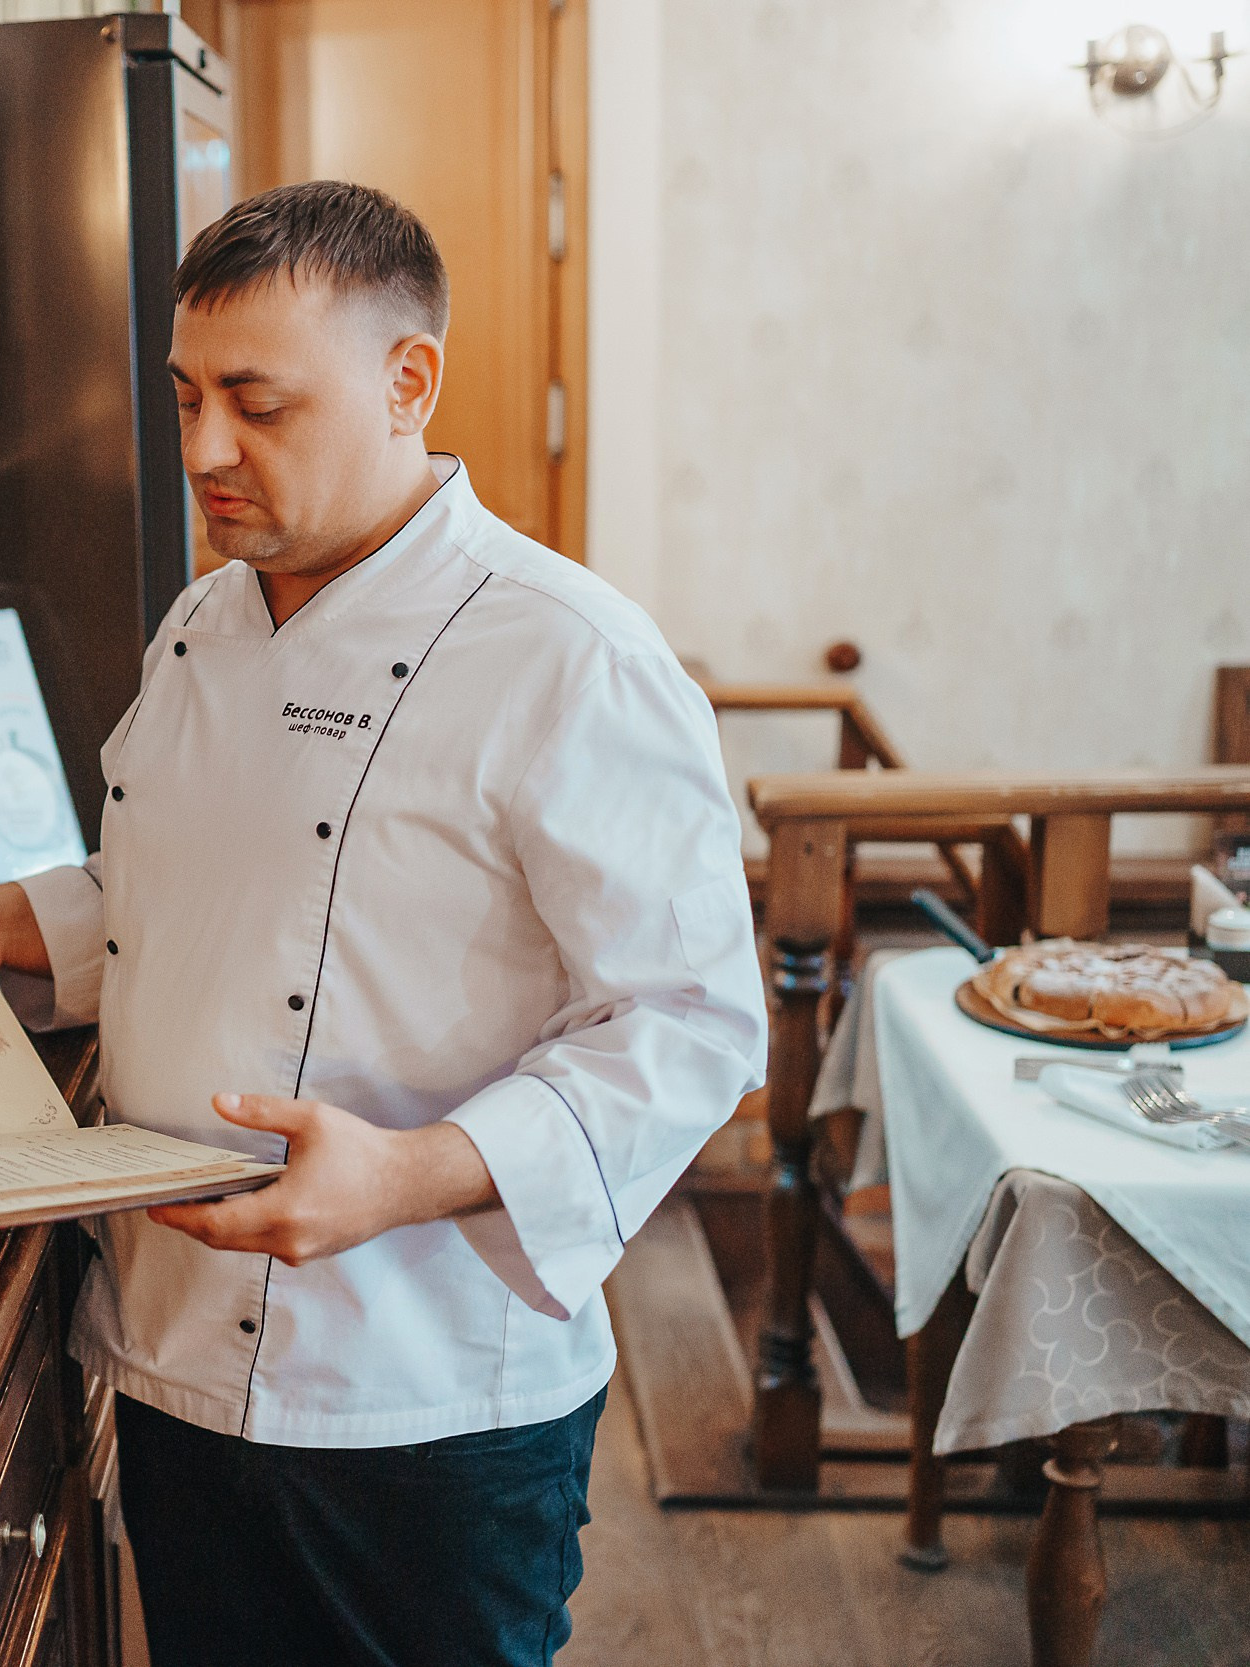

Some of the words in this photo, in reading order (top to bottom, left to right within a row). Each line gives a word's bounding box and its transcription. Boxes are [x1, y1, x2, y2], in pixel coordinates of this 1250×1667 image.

[282, 702, 354, 725] Бессонов
[357, 714, 372, 730] В.
[288, 723, 347, 740] шеф-повар
